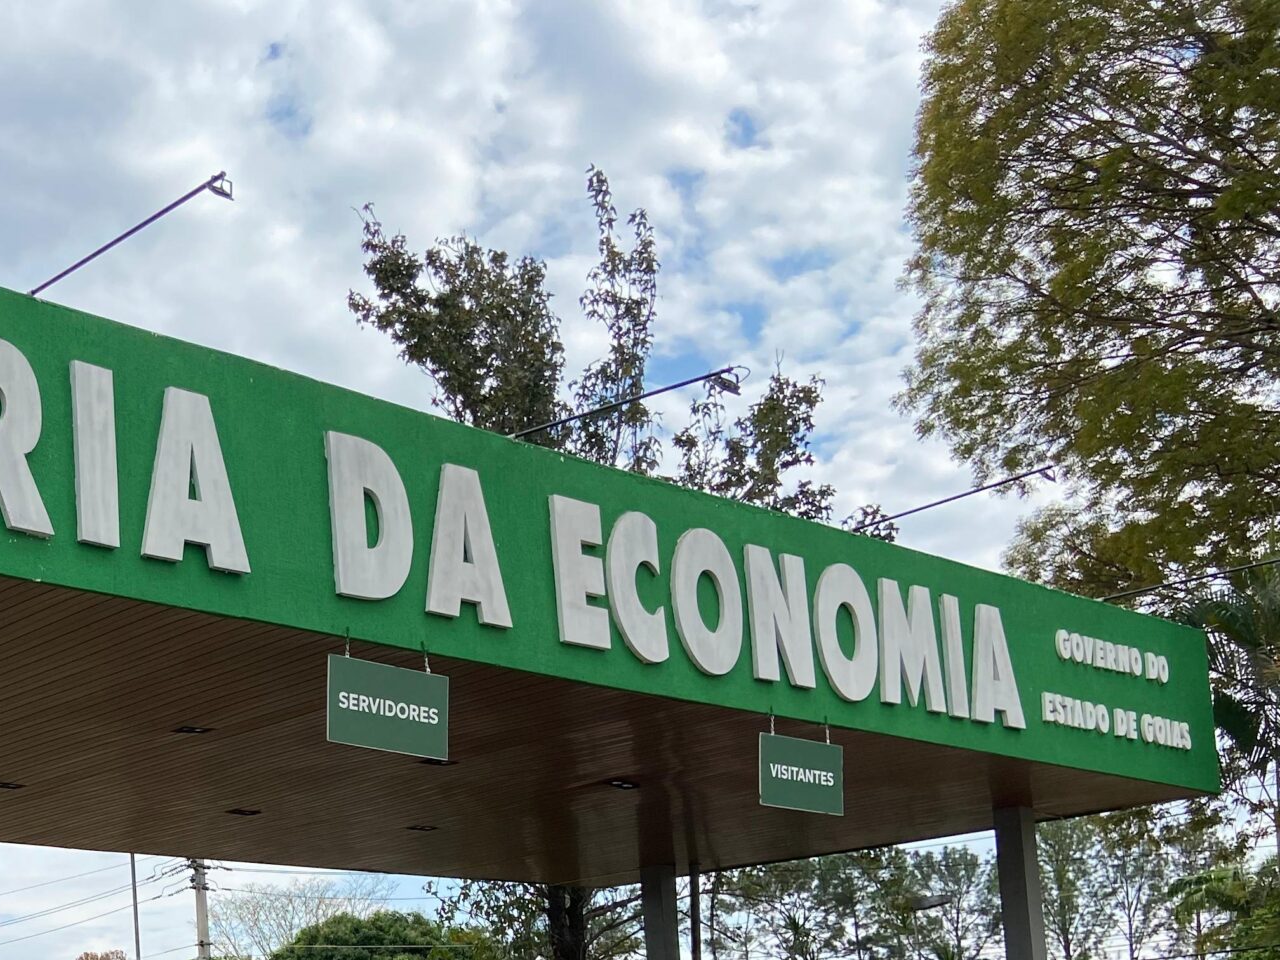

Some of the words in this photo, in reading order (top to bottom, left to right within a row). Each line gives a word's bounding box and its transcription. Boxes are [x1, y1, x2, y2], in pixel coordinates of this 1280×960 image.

[324, 430, 514, 629] DA
[549, 494, 1027, 731] ECONOMIA
[1055, 629, 1142, 677] GOVERNO
[1144, 652, 1169, 684] DO
[338, 691, 439, 725] SERVIDORES
[1041, 691, 1110, 734] ESTADO
[1113, 708, 1138, 740] DE
[769, 763, 835, 787] VISITANTES
